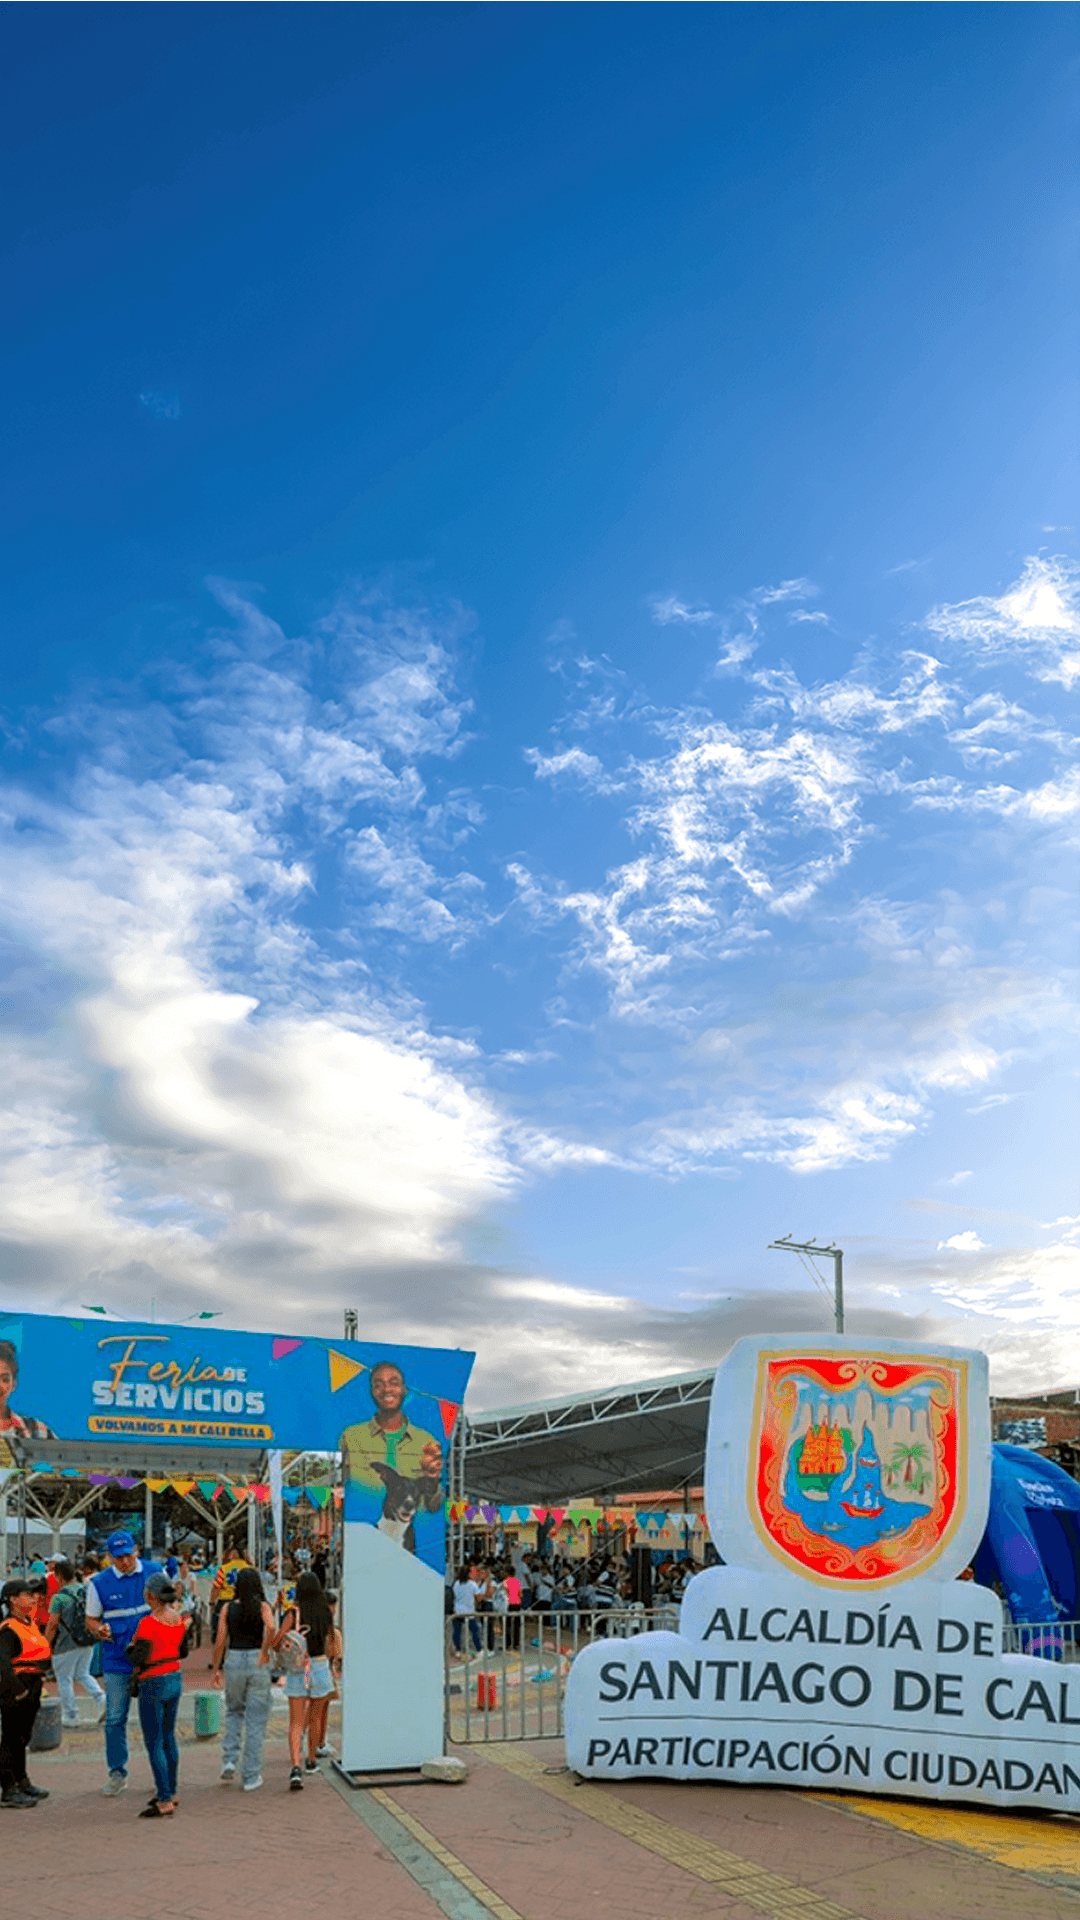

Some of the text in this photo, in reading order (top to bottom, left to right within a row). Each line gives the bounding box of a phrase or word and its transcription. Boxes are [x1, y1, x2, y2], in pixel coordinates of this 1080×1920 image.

[97, 1336, 247, 1393] Feria DE
[92, 1380, 266, 1414] SERVICIOS
[95, 1418, 265, 1438] VOLVAMOS A MI CALI BELLA
[702, 1603, 995, 1657] ALCALDÍA DE
[598, 1660, 1080, 1725] SANTIAGO DE CAL
[586, 1734, 871, 1777] PARTICIPACIÓN
